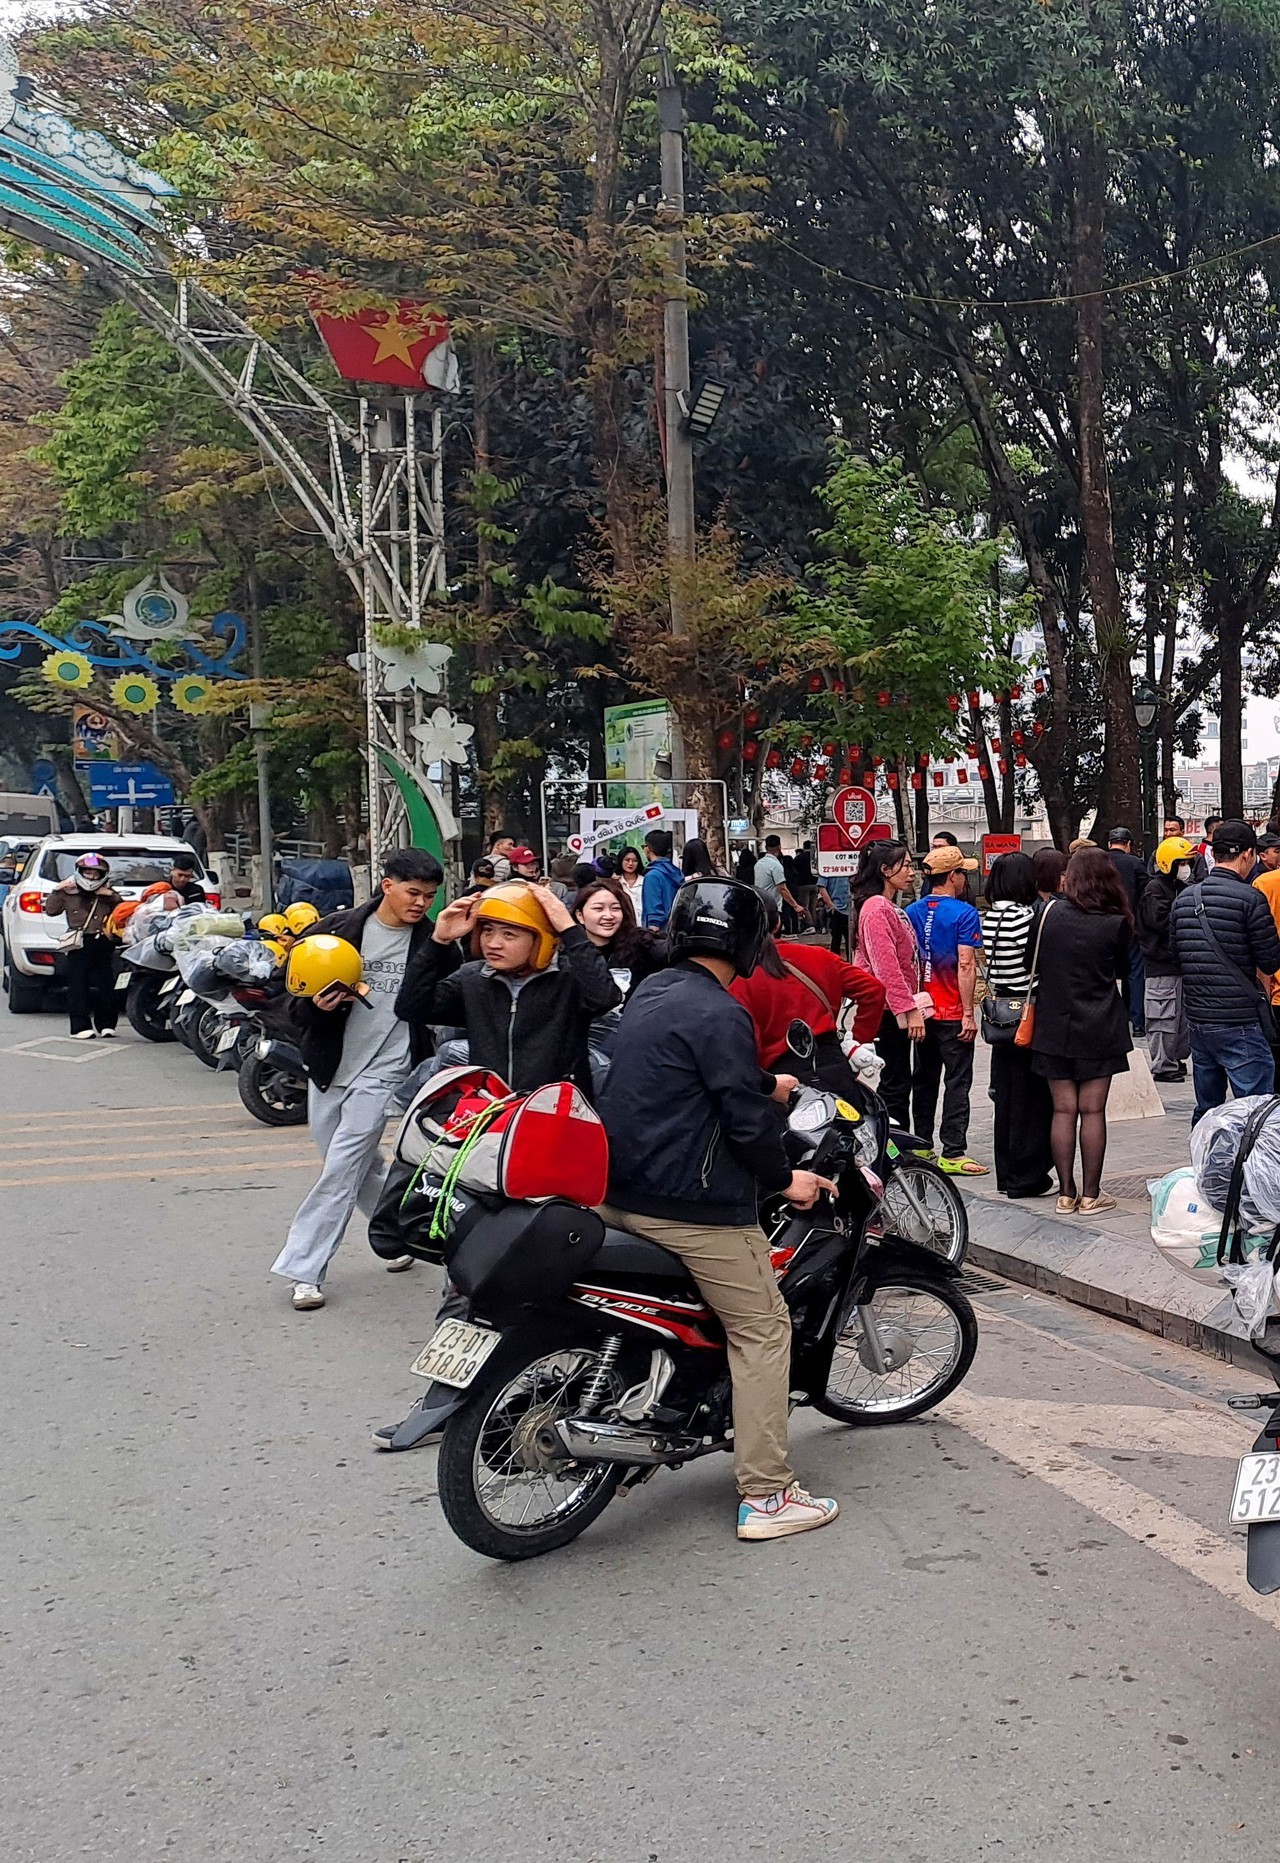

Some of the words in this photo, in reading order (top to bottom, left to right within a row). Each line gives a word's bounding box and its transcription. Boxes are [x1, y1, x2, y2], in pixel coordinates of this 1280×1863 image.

[696, 915, 729, 929] HONDA
[414, 1172, 466, 1213] Supme
[580, 1293, 661, 1316] BLADE
[438, 1325, 490, 1358] 23-D1
[418, 1348, 478, 1382] 518.09
